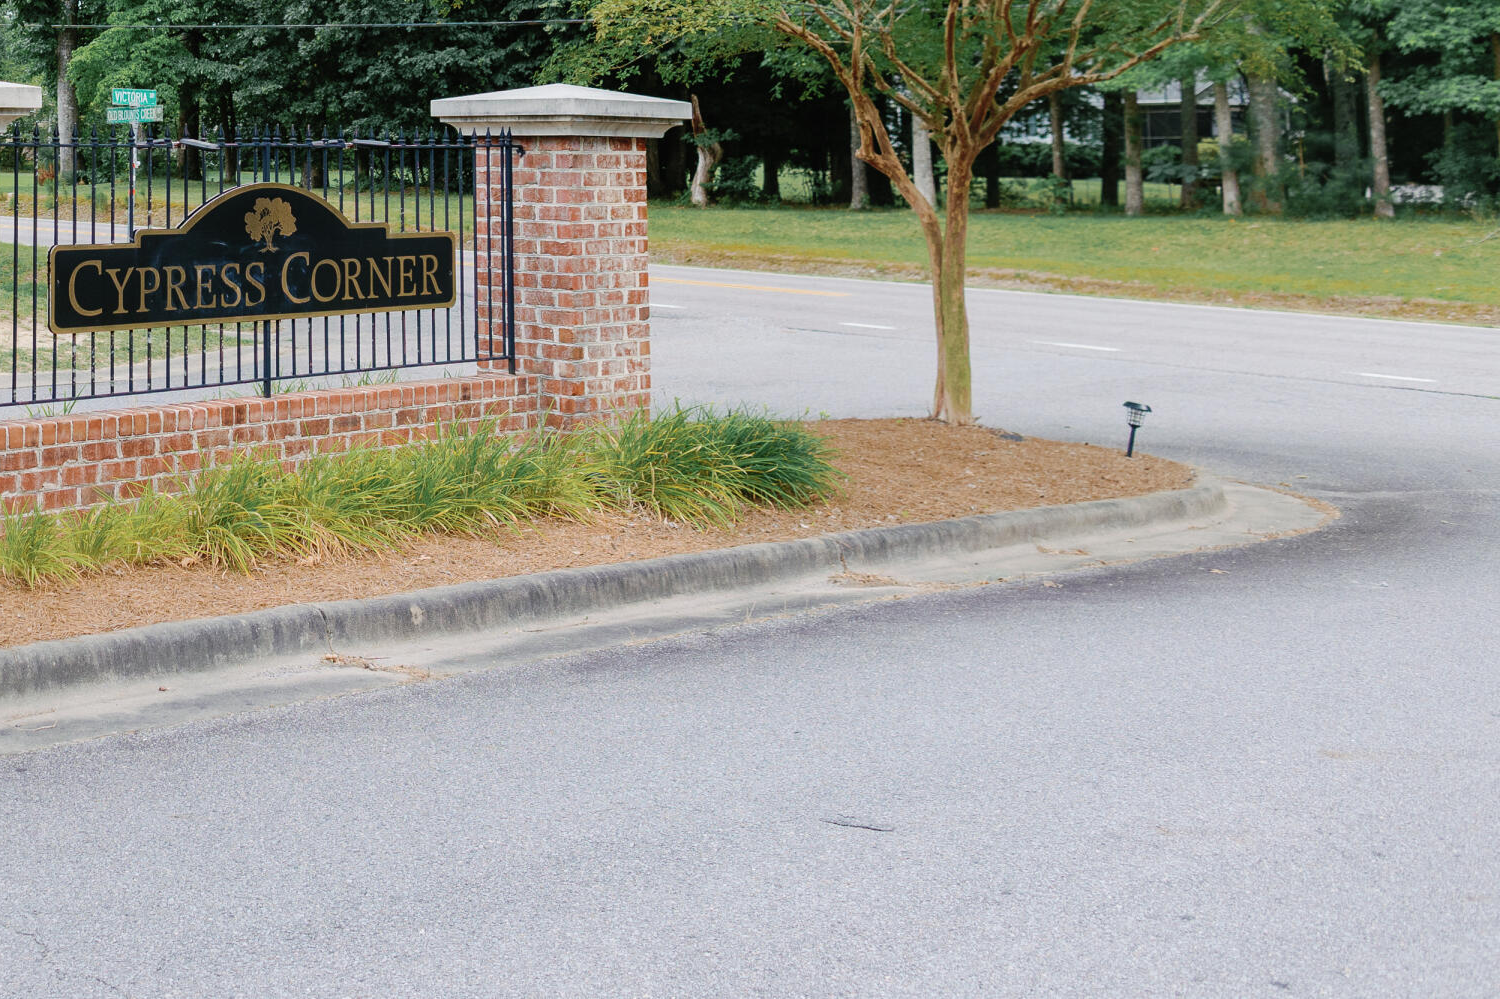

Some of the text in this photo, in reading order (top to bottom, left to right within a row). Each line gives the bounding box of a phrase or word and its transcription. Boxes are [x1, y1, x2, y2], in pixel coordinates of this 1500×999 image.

[115, 91, 148, 104] VICTORIA
[68, 251, 443, 317] CYPRESS CORNER
